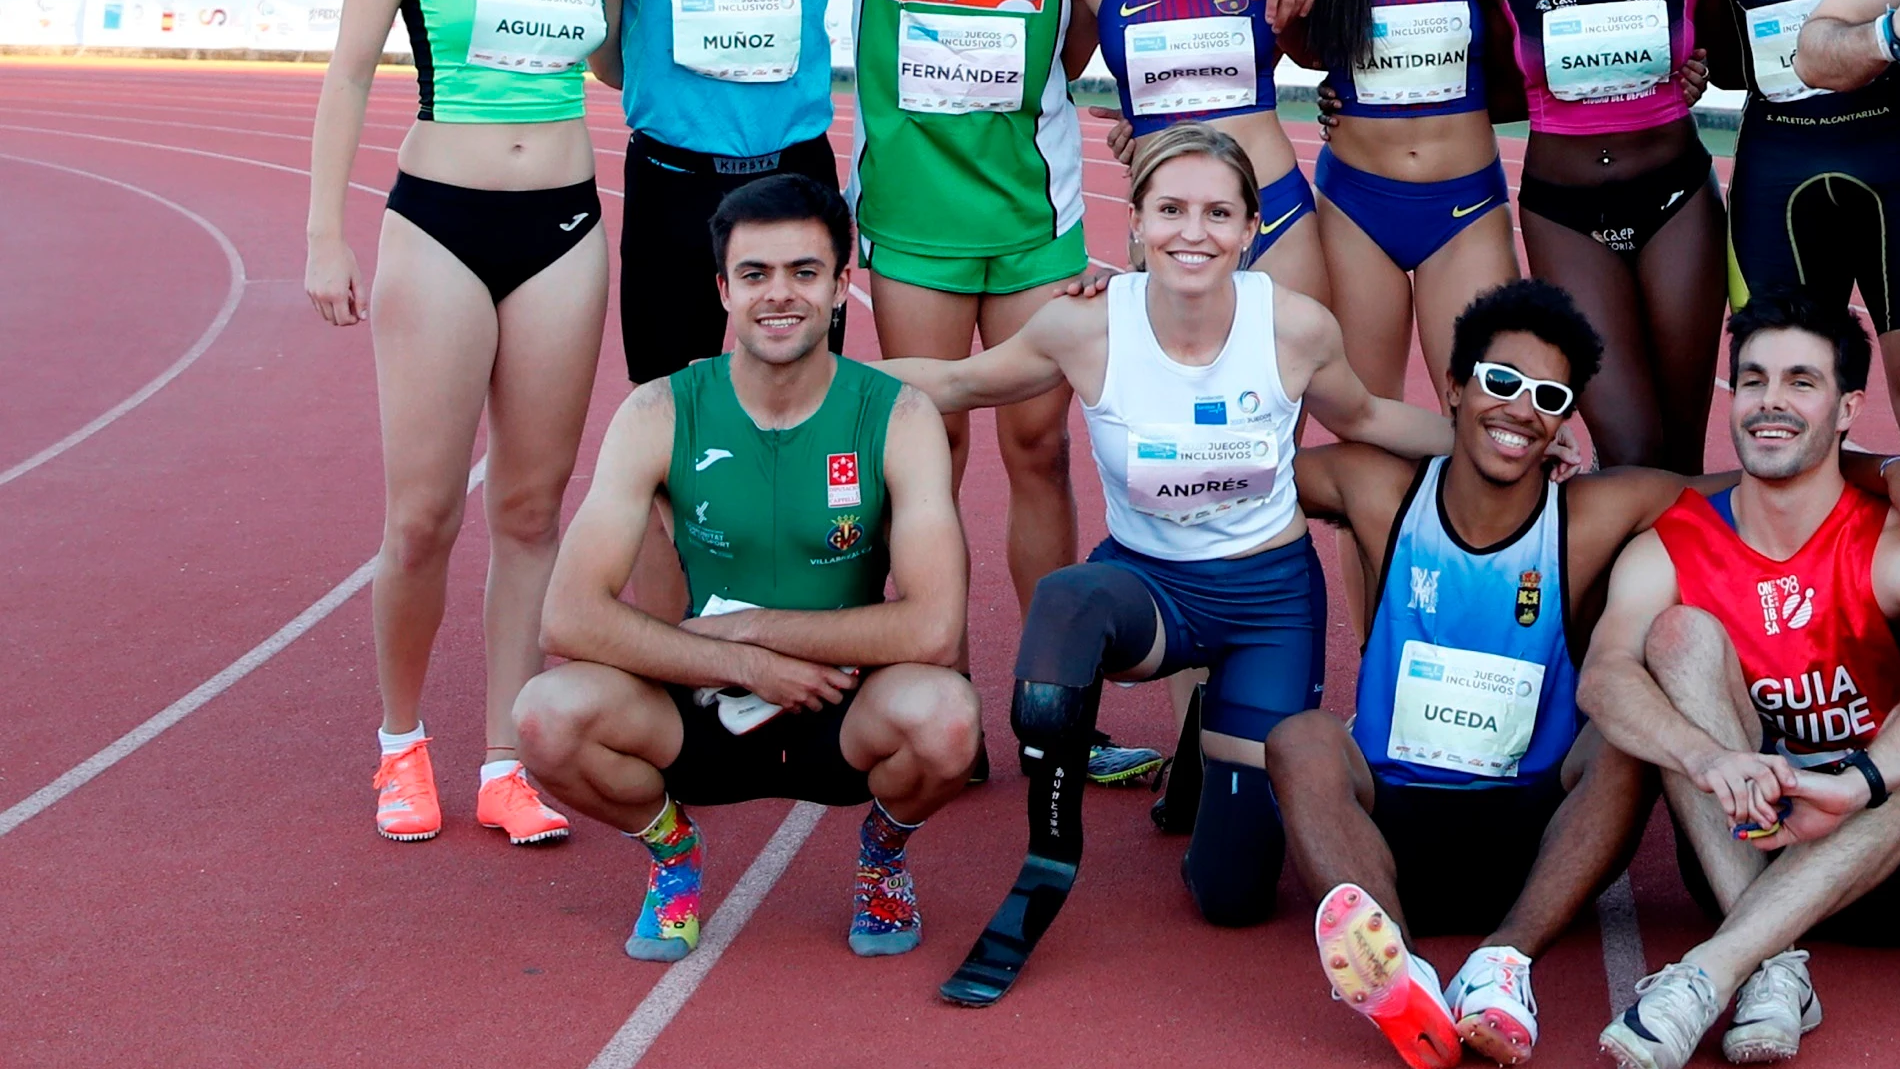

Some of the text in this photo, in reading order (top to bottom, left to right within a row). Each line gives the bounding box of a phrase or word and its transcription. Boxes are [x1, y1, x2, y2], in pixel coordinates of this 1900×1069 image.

[718, 3, 780, 12] INCLUSIVOS
[1412, 17, 1448, 27] JUEGOS
[1607, 14, 1643, 24] JUEGOS
[495, 18, 585, 40] AGUILAR
[1391, 25, 1449, 37] INCLUSIVOS
[1585, 22, 1644, 33] INCLUSIVOS
[703, 31, 775, 50] MUÑOZ
[964, 31, 1002, 40] JUEGOS
[1192, 31, 1229, 41] JUEGOS
[941, 38, 1002, 48] INCLUSIVOS
[1170, 39, 1230, 50] INCLUSIVOS
[1561, 49, 1652, 70] SANTANA
[901, 62, 1019, 83] FERNÁNDEZ
[1144, 66, 1239, 84] BORRERO
[1819, 106, 1890, 125] ALCANTARILLA
[720, 159, 774, 171] KIPSTA
[1608, 241, 1636, 251] ORIA
[1208, 441, 1252, 451] JUEGOS
[1180, 450, 1252, 461] INCLUSIVOS
[1156, 477, 1249, 497] ANDRÉS
[1473, 670, 1516, 685] JUEGOS
[1446, 675, 1514, 695] INCLUSIVOS
[1750, 665, 1858, 711] GUIA
[1424, 704, 1498, 732] UCEDA
